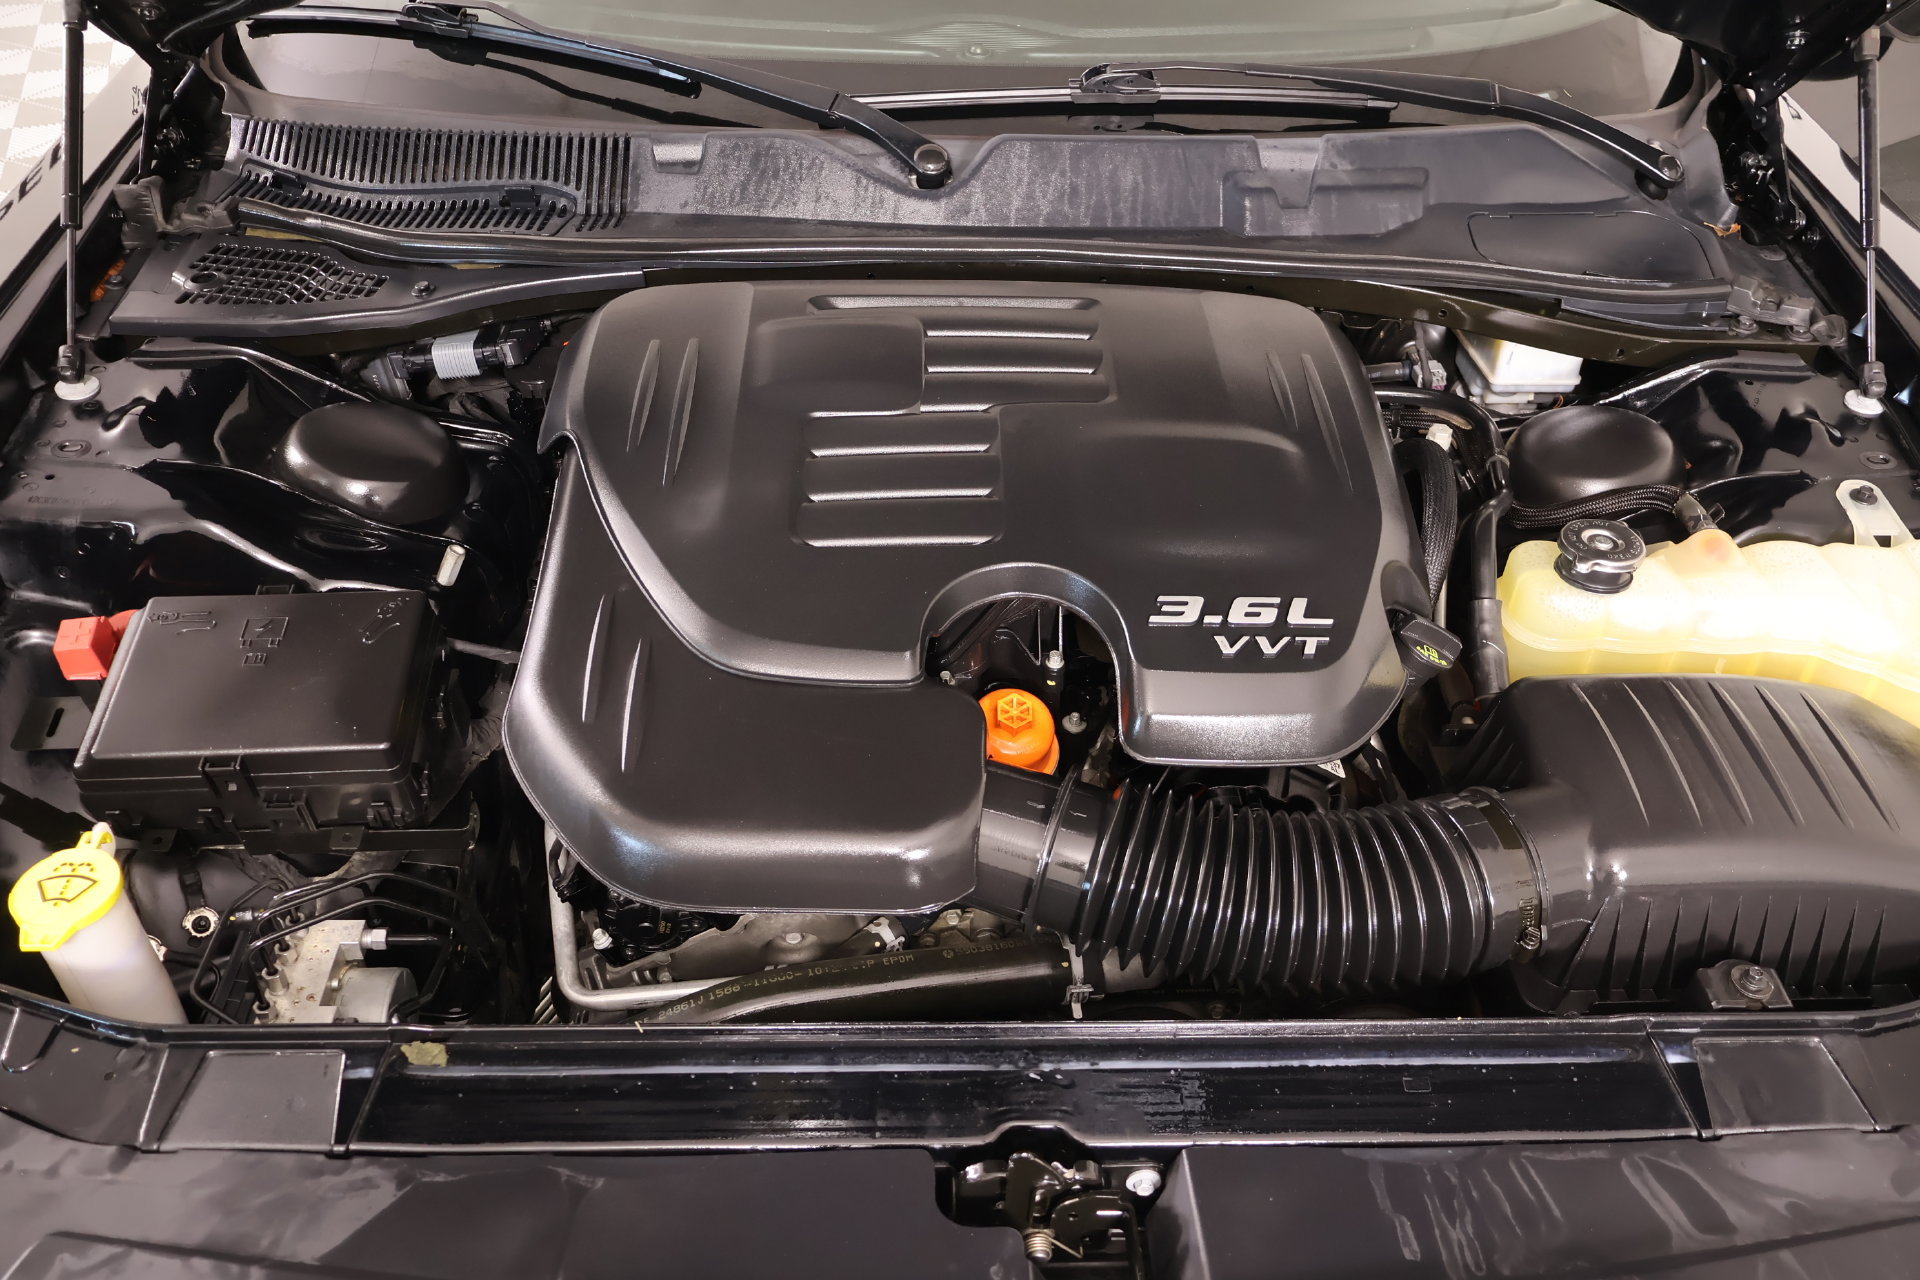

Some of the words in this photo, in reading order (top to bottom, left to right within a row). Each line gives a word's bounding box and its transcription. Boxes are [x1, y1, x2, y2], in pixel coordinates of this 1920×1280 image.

[1148, 595, 1334, 628] 3.6L
[1213, 635, 1330, 659] VVT
[883, 954, 914, 966] EPDM
